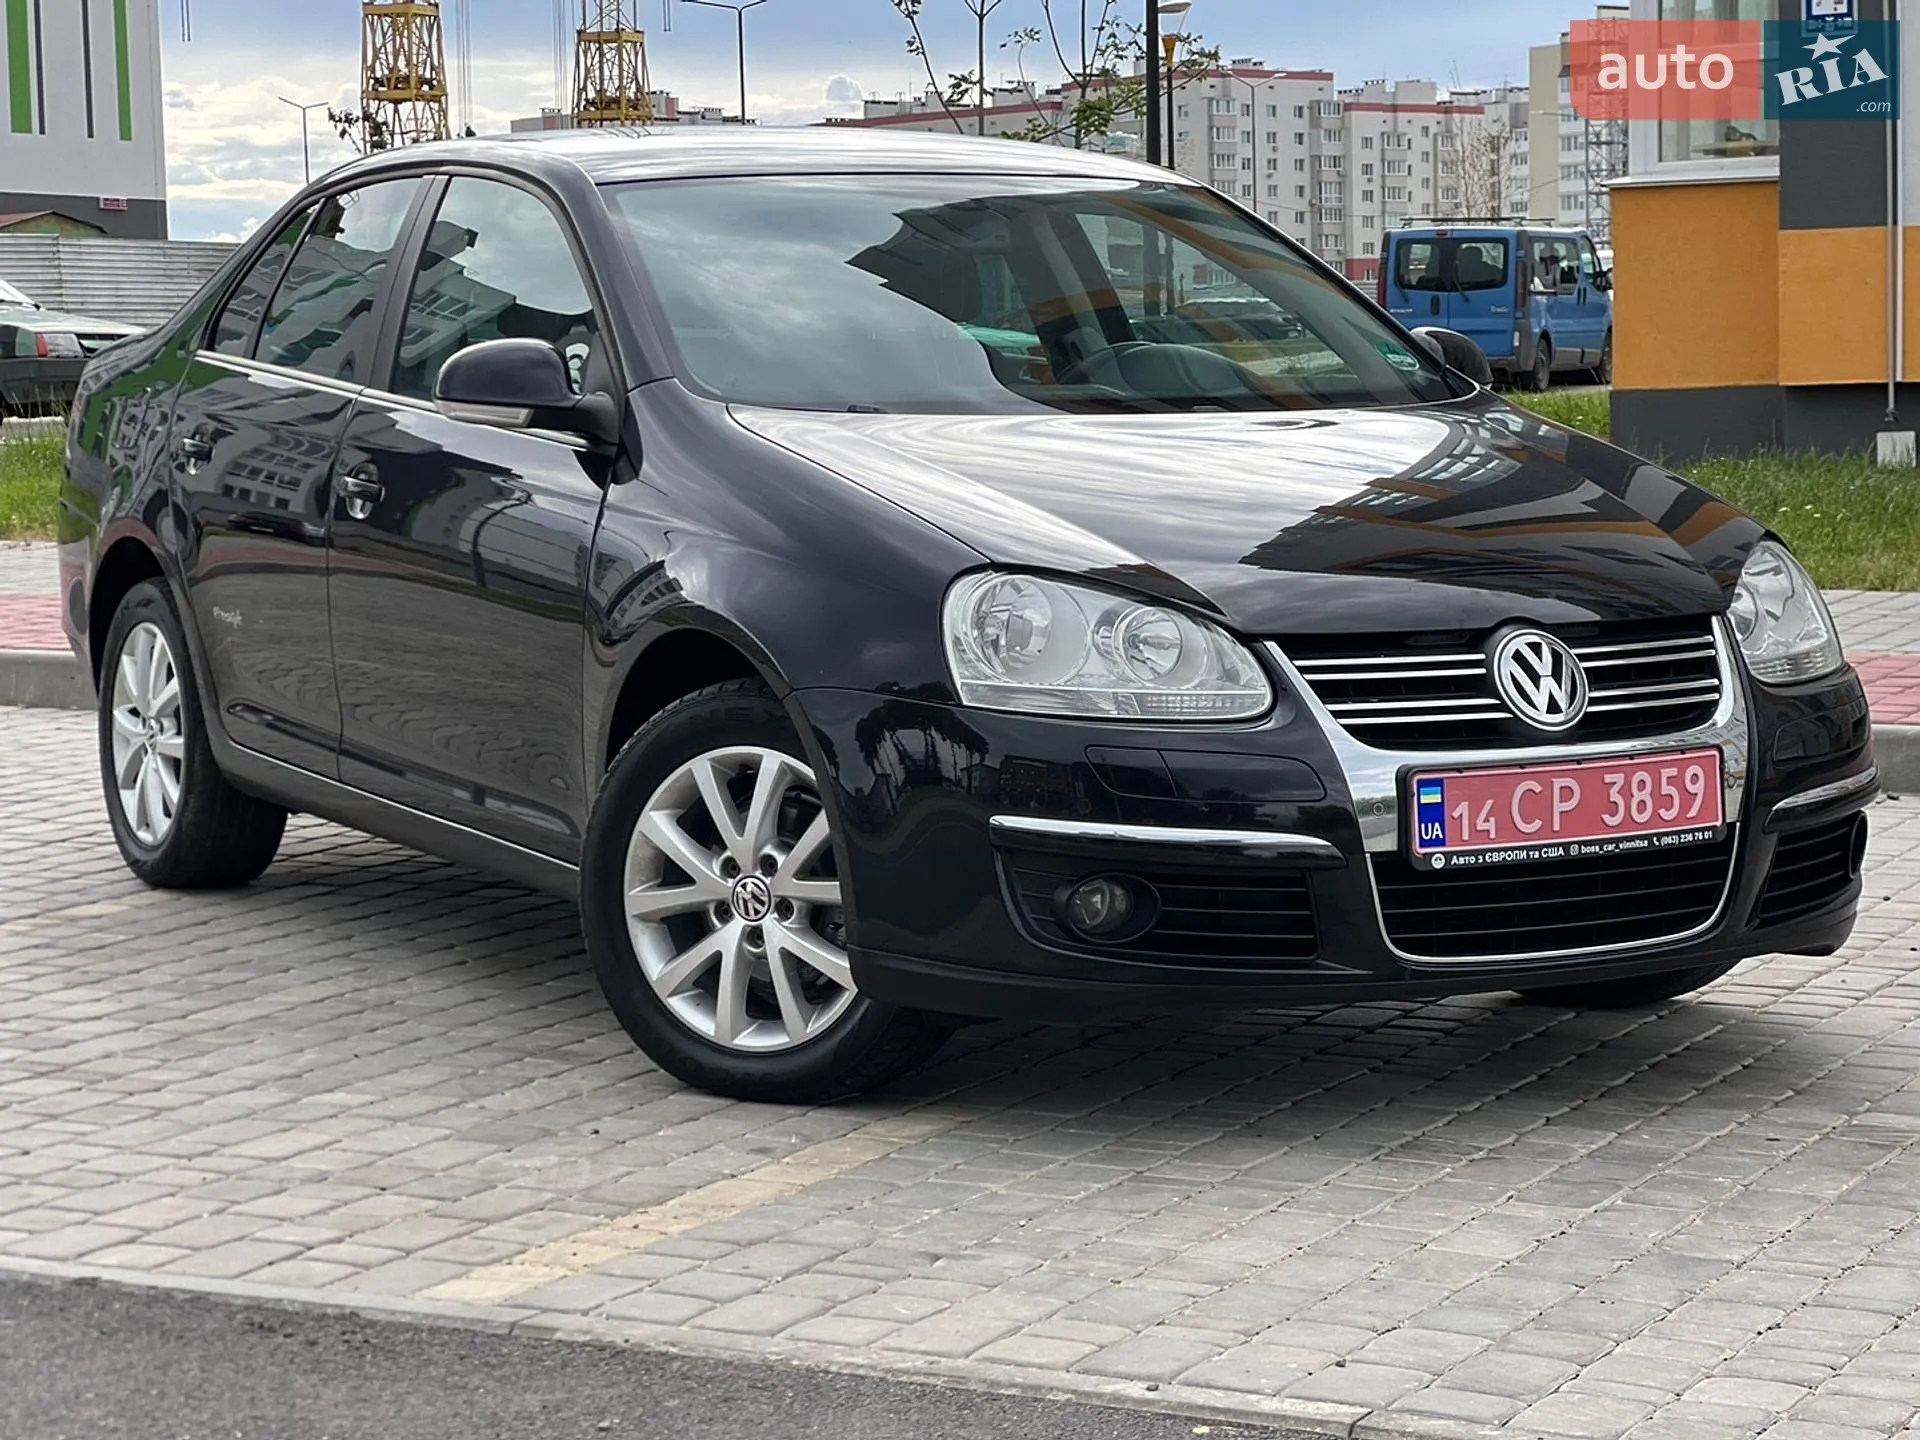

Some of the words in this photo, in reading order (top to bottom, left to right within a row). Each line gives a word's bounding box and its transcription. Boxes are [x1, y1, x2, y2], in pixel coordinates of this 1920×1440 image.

[1451, 800, 1496, 841] 14
[1601, 764, 1705, 827] 3859
[1421, 823, 1443, 840] UA
[1704, 830, 1713, 839] 01
[1581, 838, 1649, 854] boss_car_vinnitsa
[1450, 855, 1476, 866] Авто
[1485, 850, 1527, 863] ЄВРОПИ
[1528, 850, 1539, 859] та
[1541, 847, 1565, 858] США
